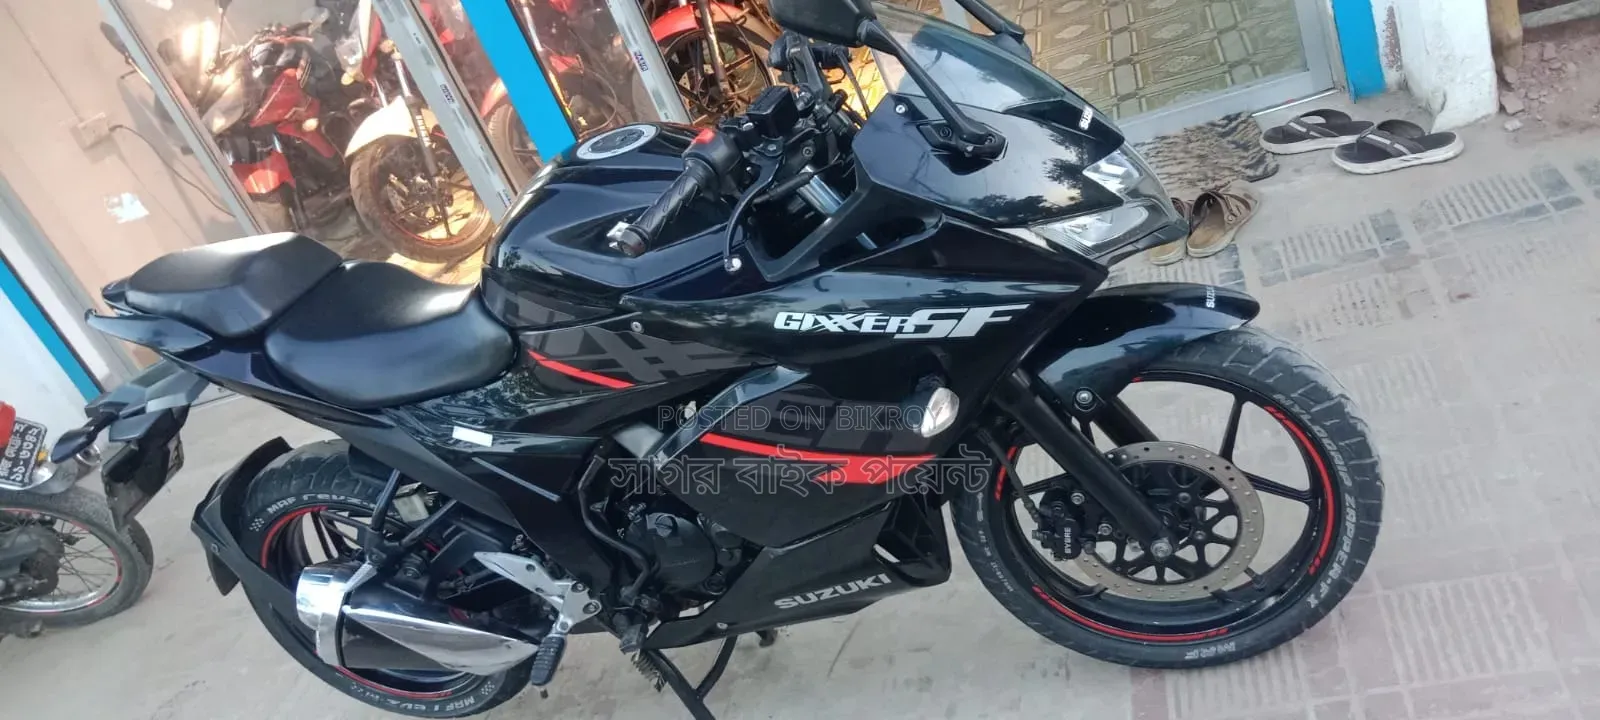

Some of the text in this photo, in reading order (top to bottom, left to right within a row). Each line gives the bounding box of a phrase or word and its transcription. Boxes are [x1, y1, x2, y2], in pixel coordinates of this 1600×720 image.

[774, 303, 1031, 339] GIXXER SF
[774, 573, 892, 609] SUZUKI
